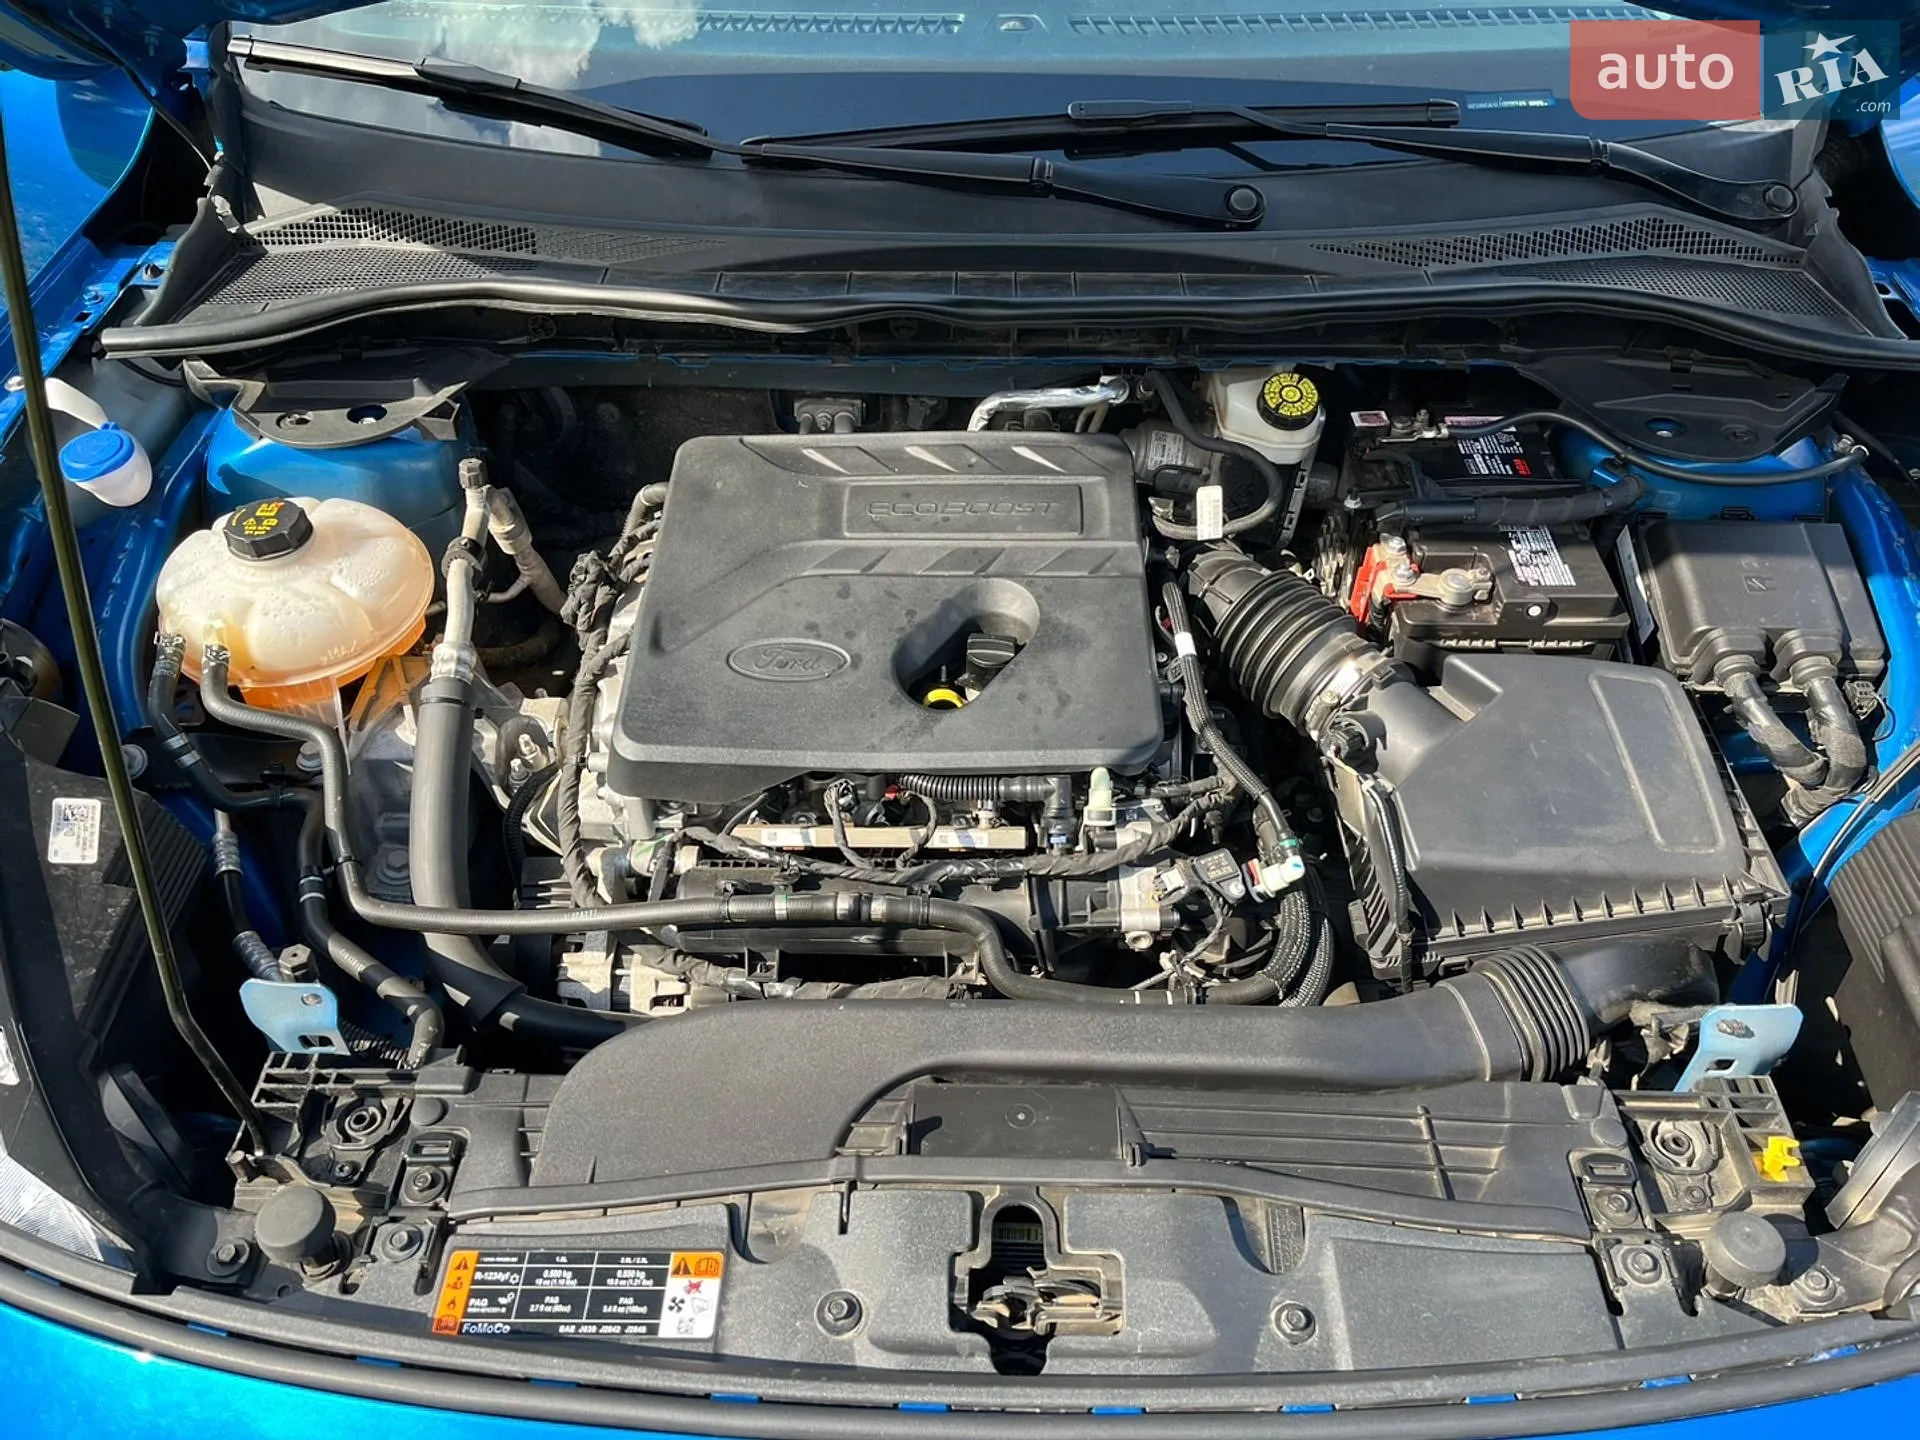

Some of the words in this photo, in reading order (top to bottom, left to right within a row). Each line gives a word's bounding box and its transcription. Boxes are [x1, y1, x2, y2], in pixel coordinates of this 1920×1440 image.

[868, 501, 1059, 517] ECOBOOST
[752, 647, 823, 672] Ford
[474, 1271, 510, 1282] R-1234yf
[468, 1298, 488, 1307] PAG
[544, 1295, 560, 1304] PAG
[618, 1297, 634, 1306] PAG
[462, 1322, 511, 1334] FoMoCo
